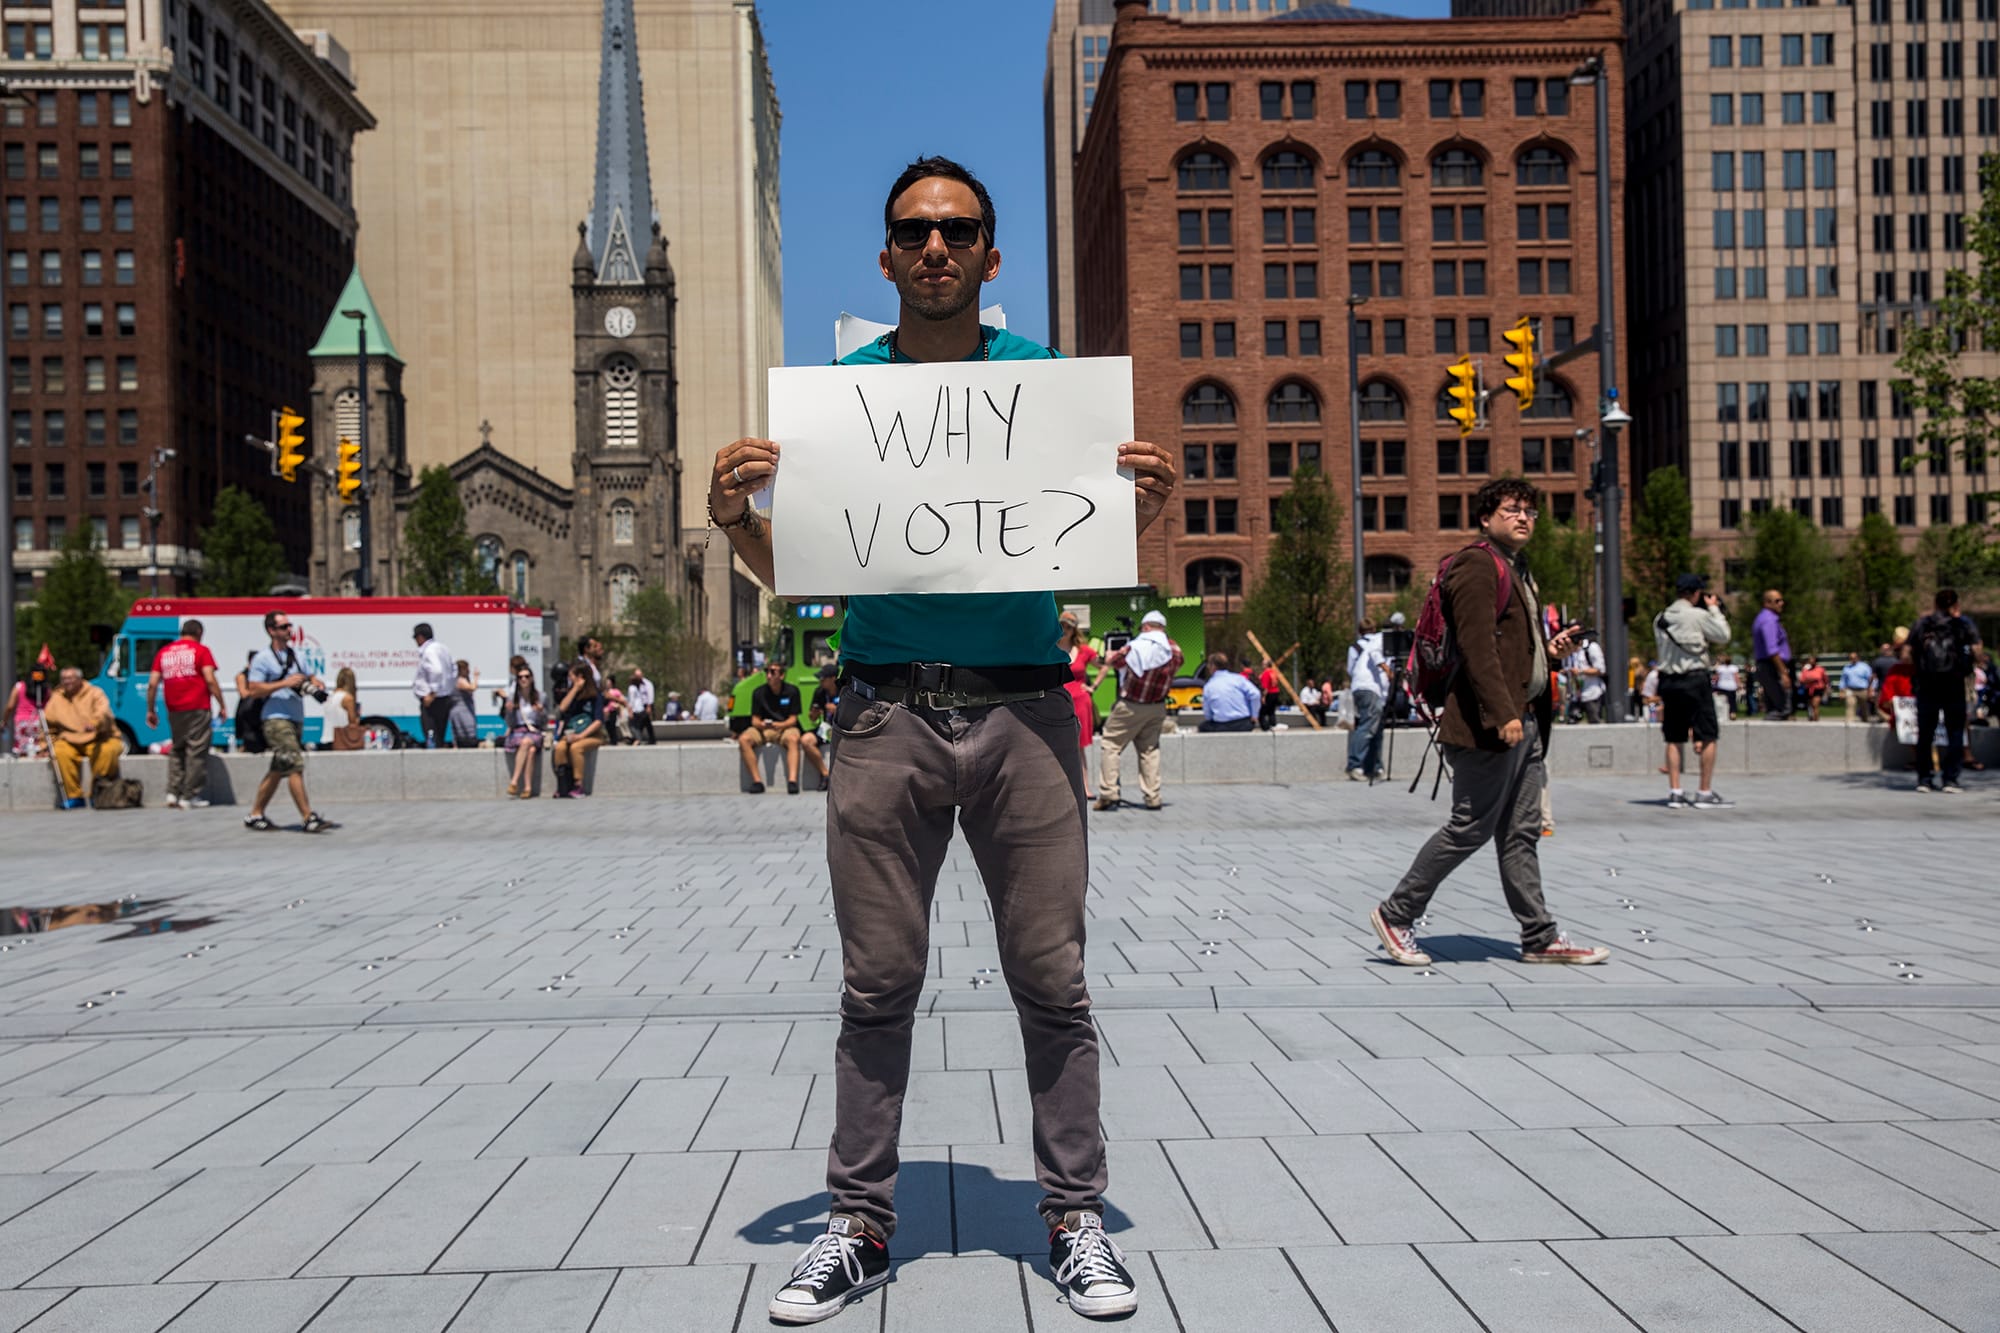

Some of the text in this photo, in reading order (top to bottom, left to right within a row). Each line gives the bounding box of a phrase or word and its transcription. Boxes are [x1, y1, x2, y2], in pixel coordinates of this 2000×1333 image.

[855, 383, 1022, 469] WHY
[844, 489, 1096, 571] VOTE?
[341, 650, 365, 659] CALL
[368, 650, 388, 658] FOR
[391, 649, 420, 658] ACTIO
[348, 660, 377, 669] FOOD
